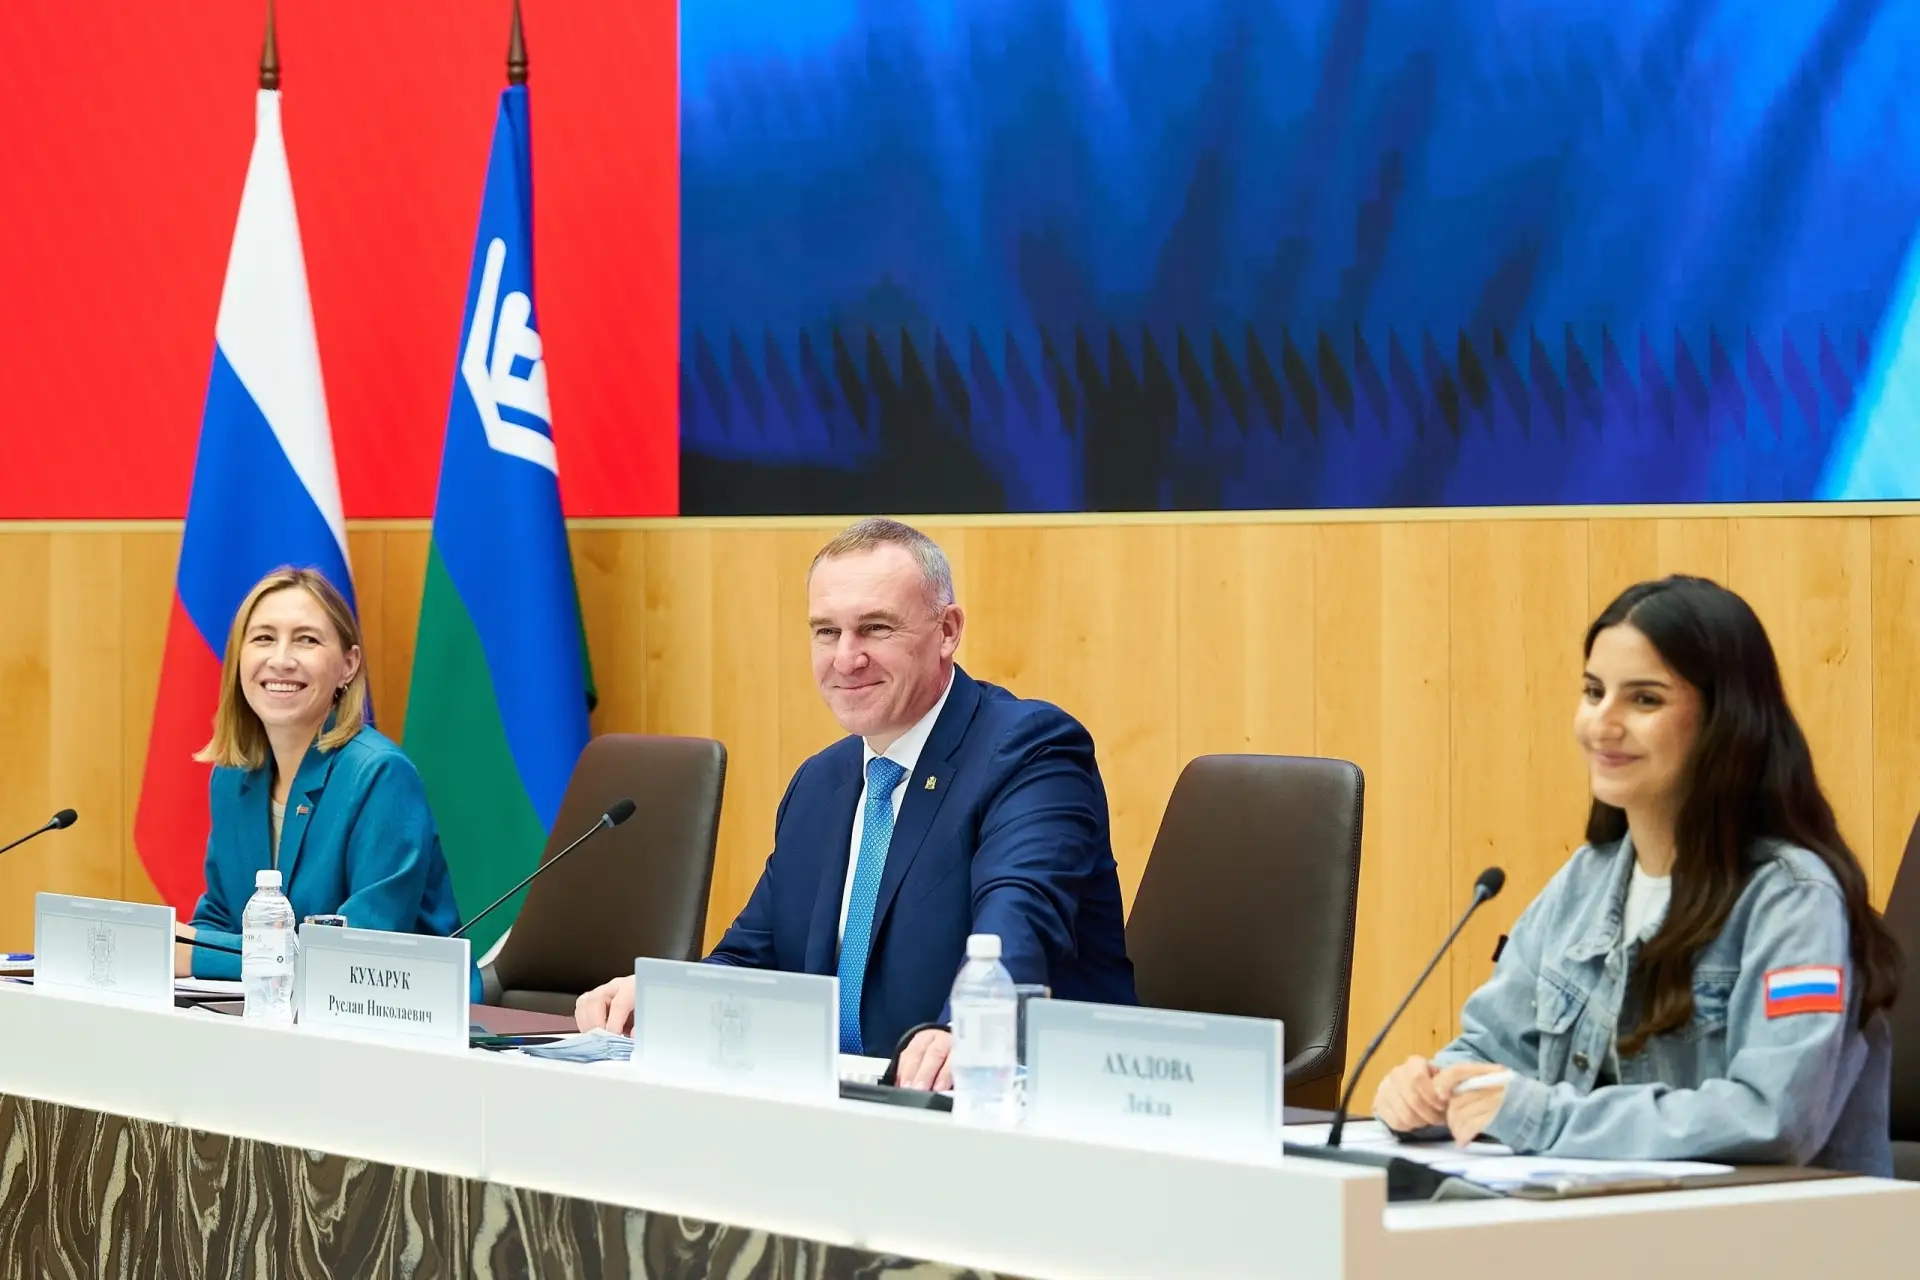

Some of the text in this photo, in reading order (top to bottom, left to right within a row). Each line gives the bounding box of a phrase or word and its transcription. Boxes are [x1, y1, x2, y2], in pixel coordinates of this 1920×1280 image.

[349, 966, 411, 990] КУХАРУК
[328, 994, 432, 1023] Руслан Николаевич
[1102, 1052, 1195, 1084] АХАДОВА
